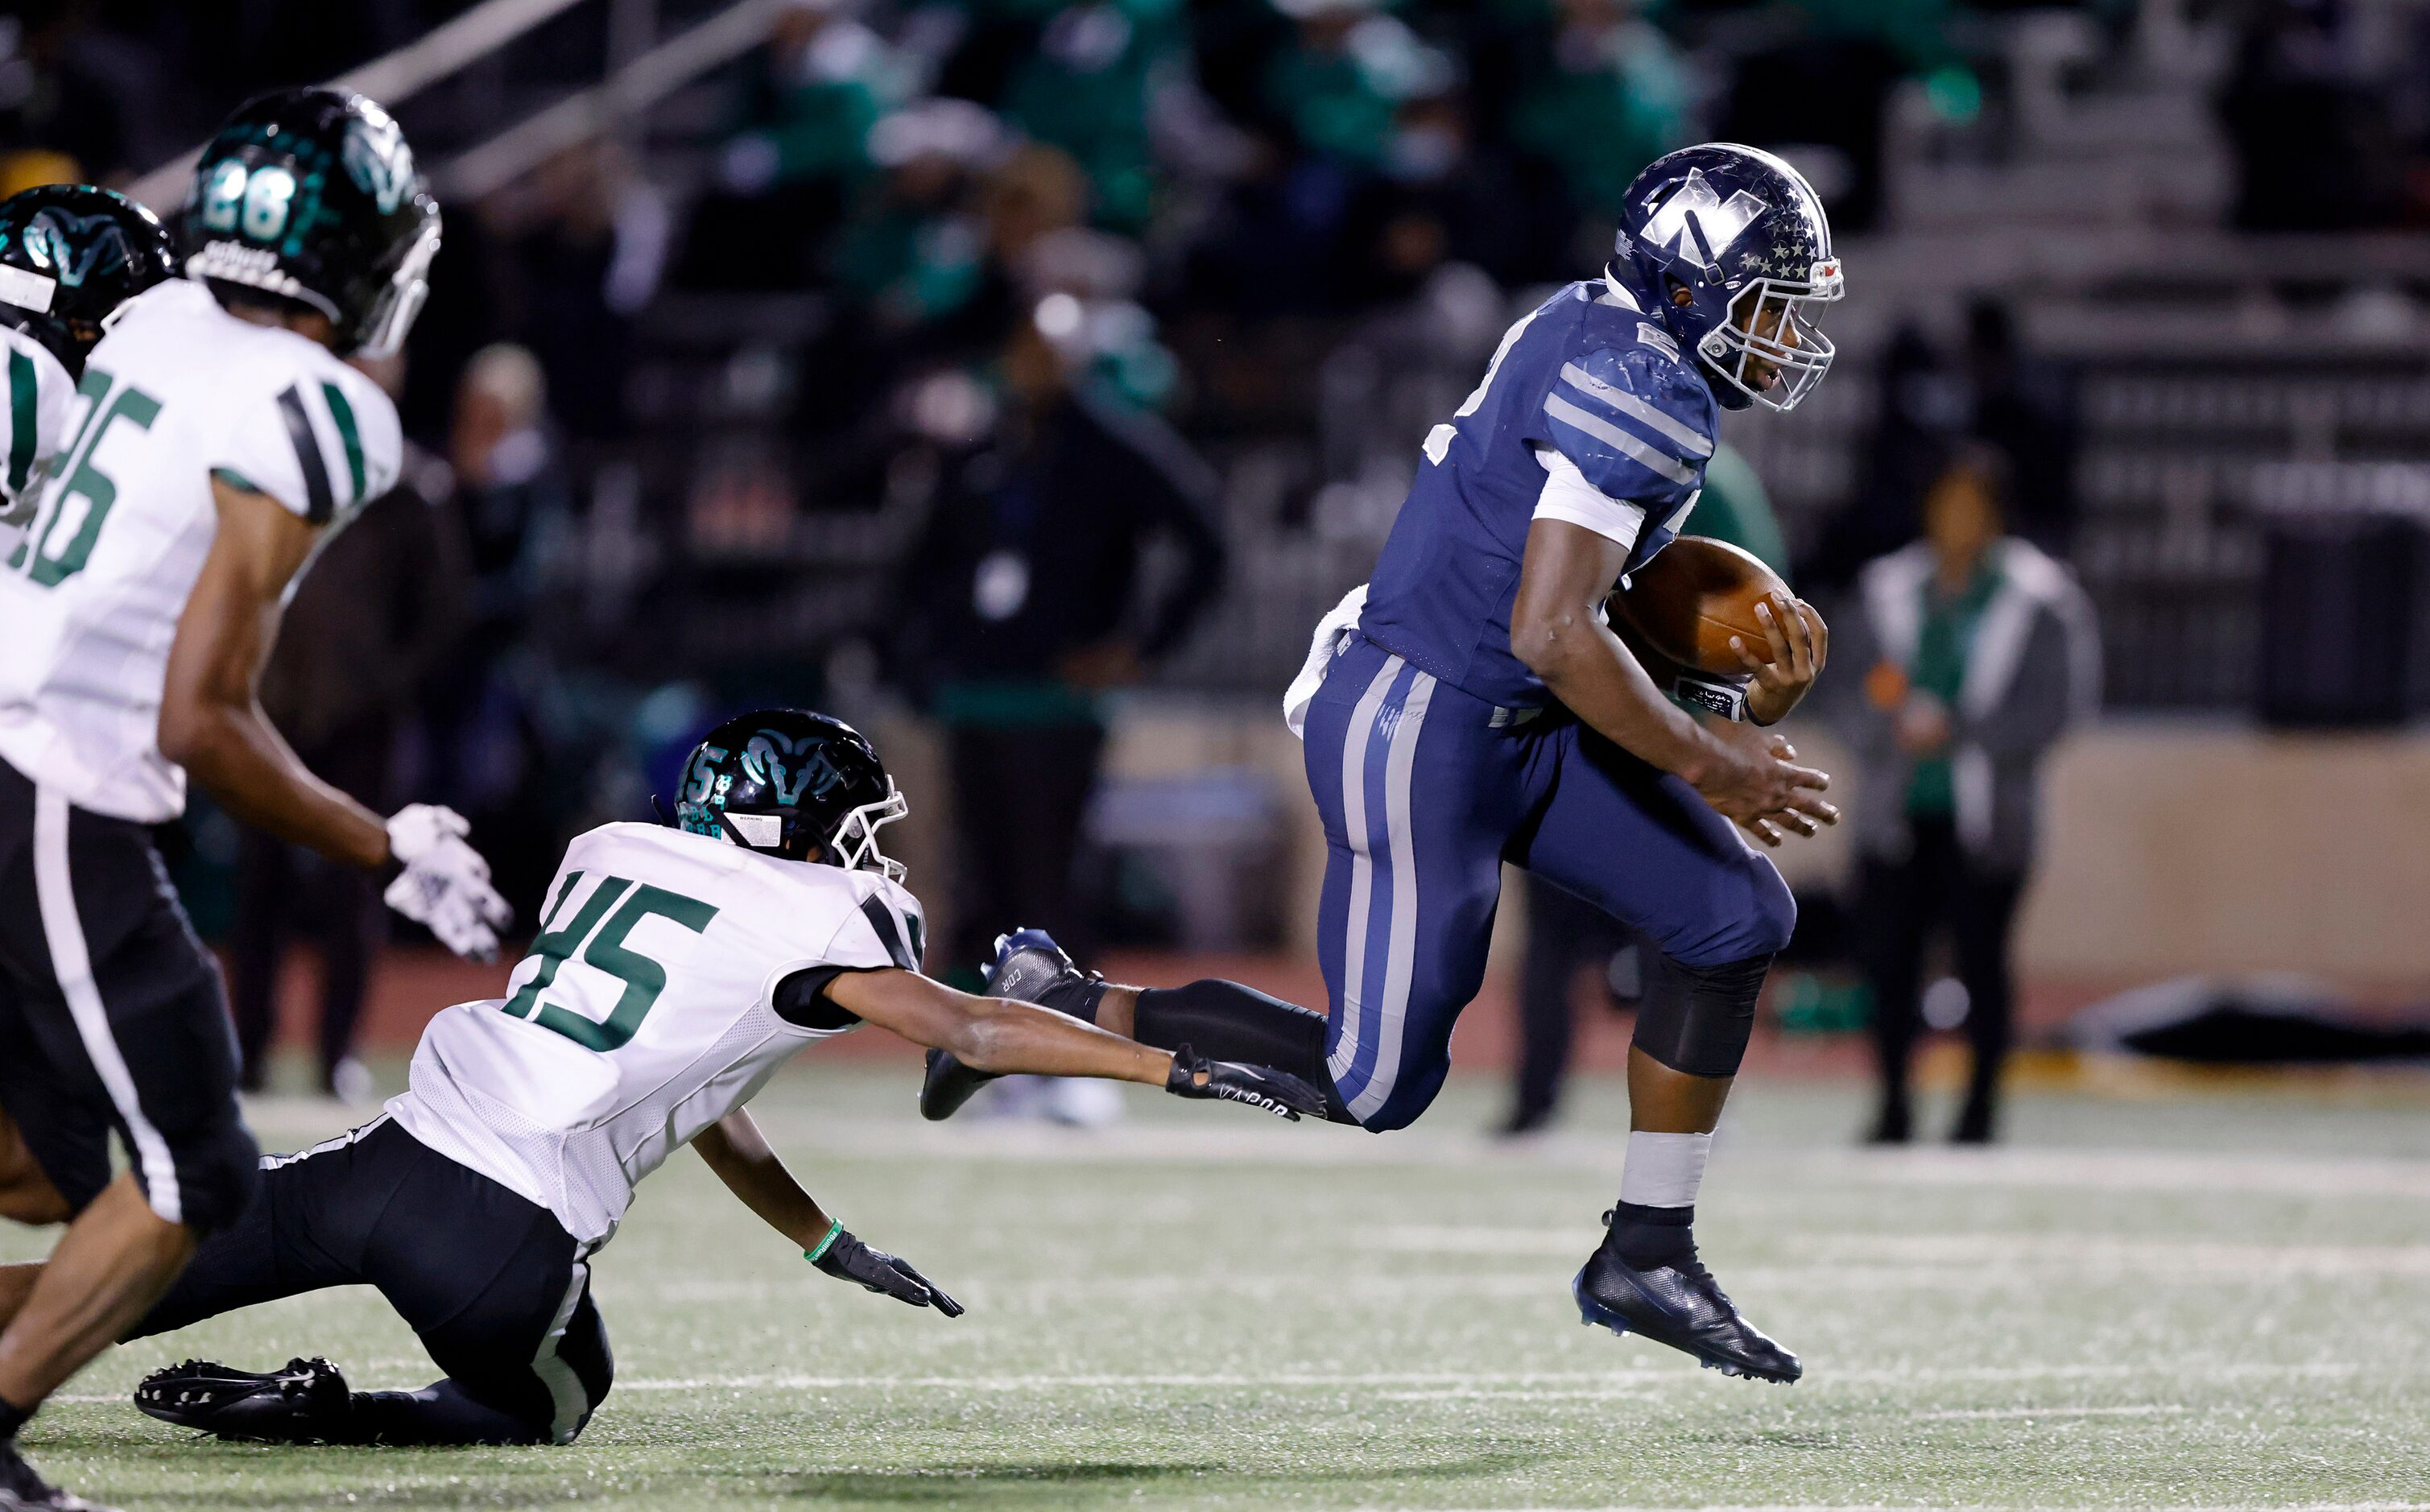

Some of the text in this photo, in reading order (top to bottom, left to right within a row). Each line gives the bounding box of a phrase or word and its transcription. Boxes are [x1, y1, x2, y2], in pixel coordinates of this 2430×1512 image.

[203, 158, 296, 241] 26
[500, 870, 721, 1052] 45
[1002, 968, 1022, 992] COR
